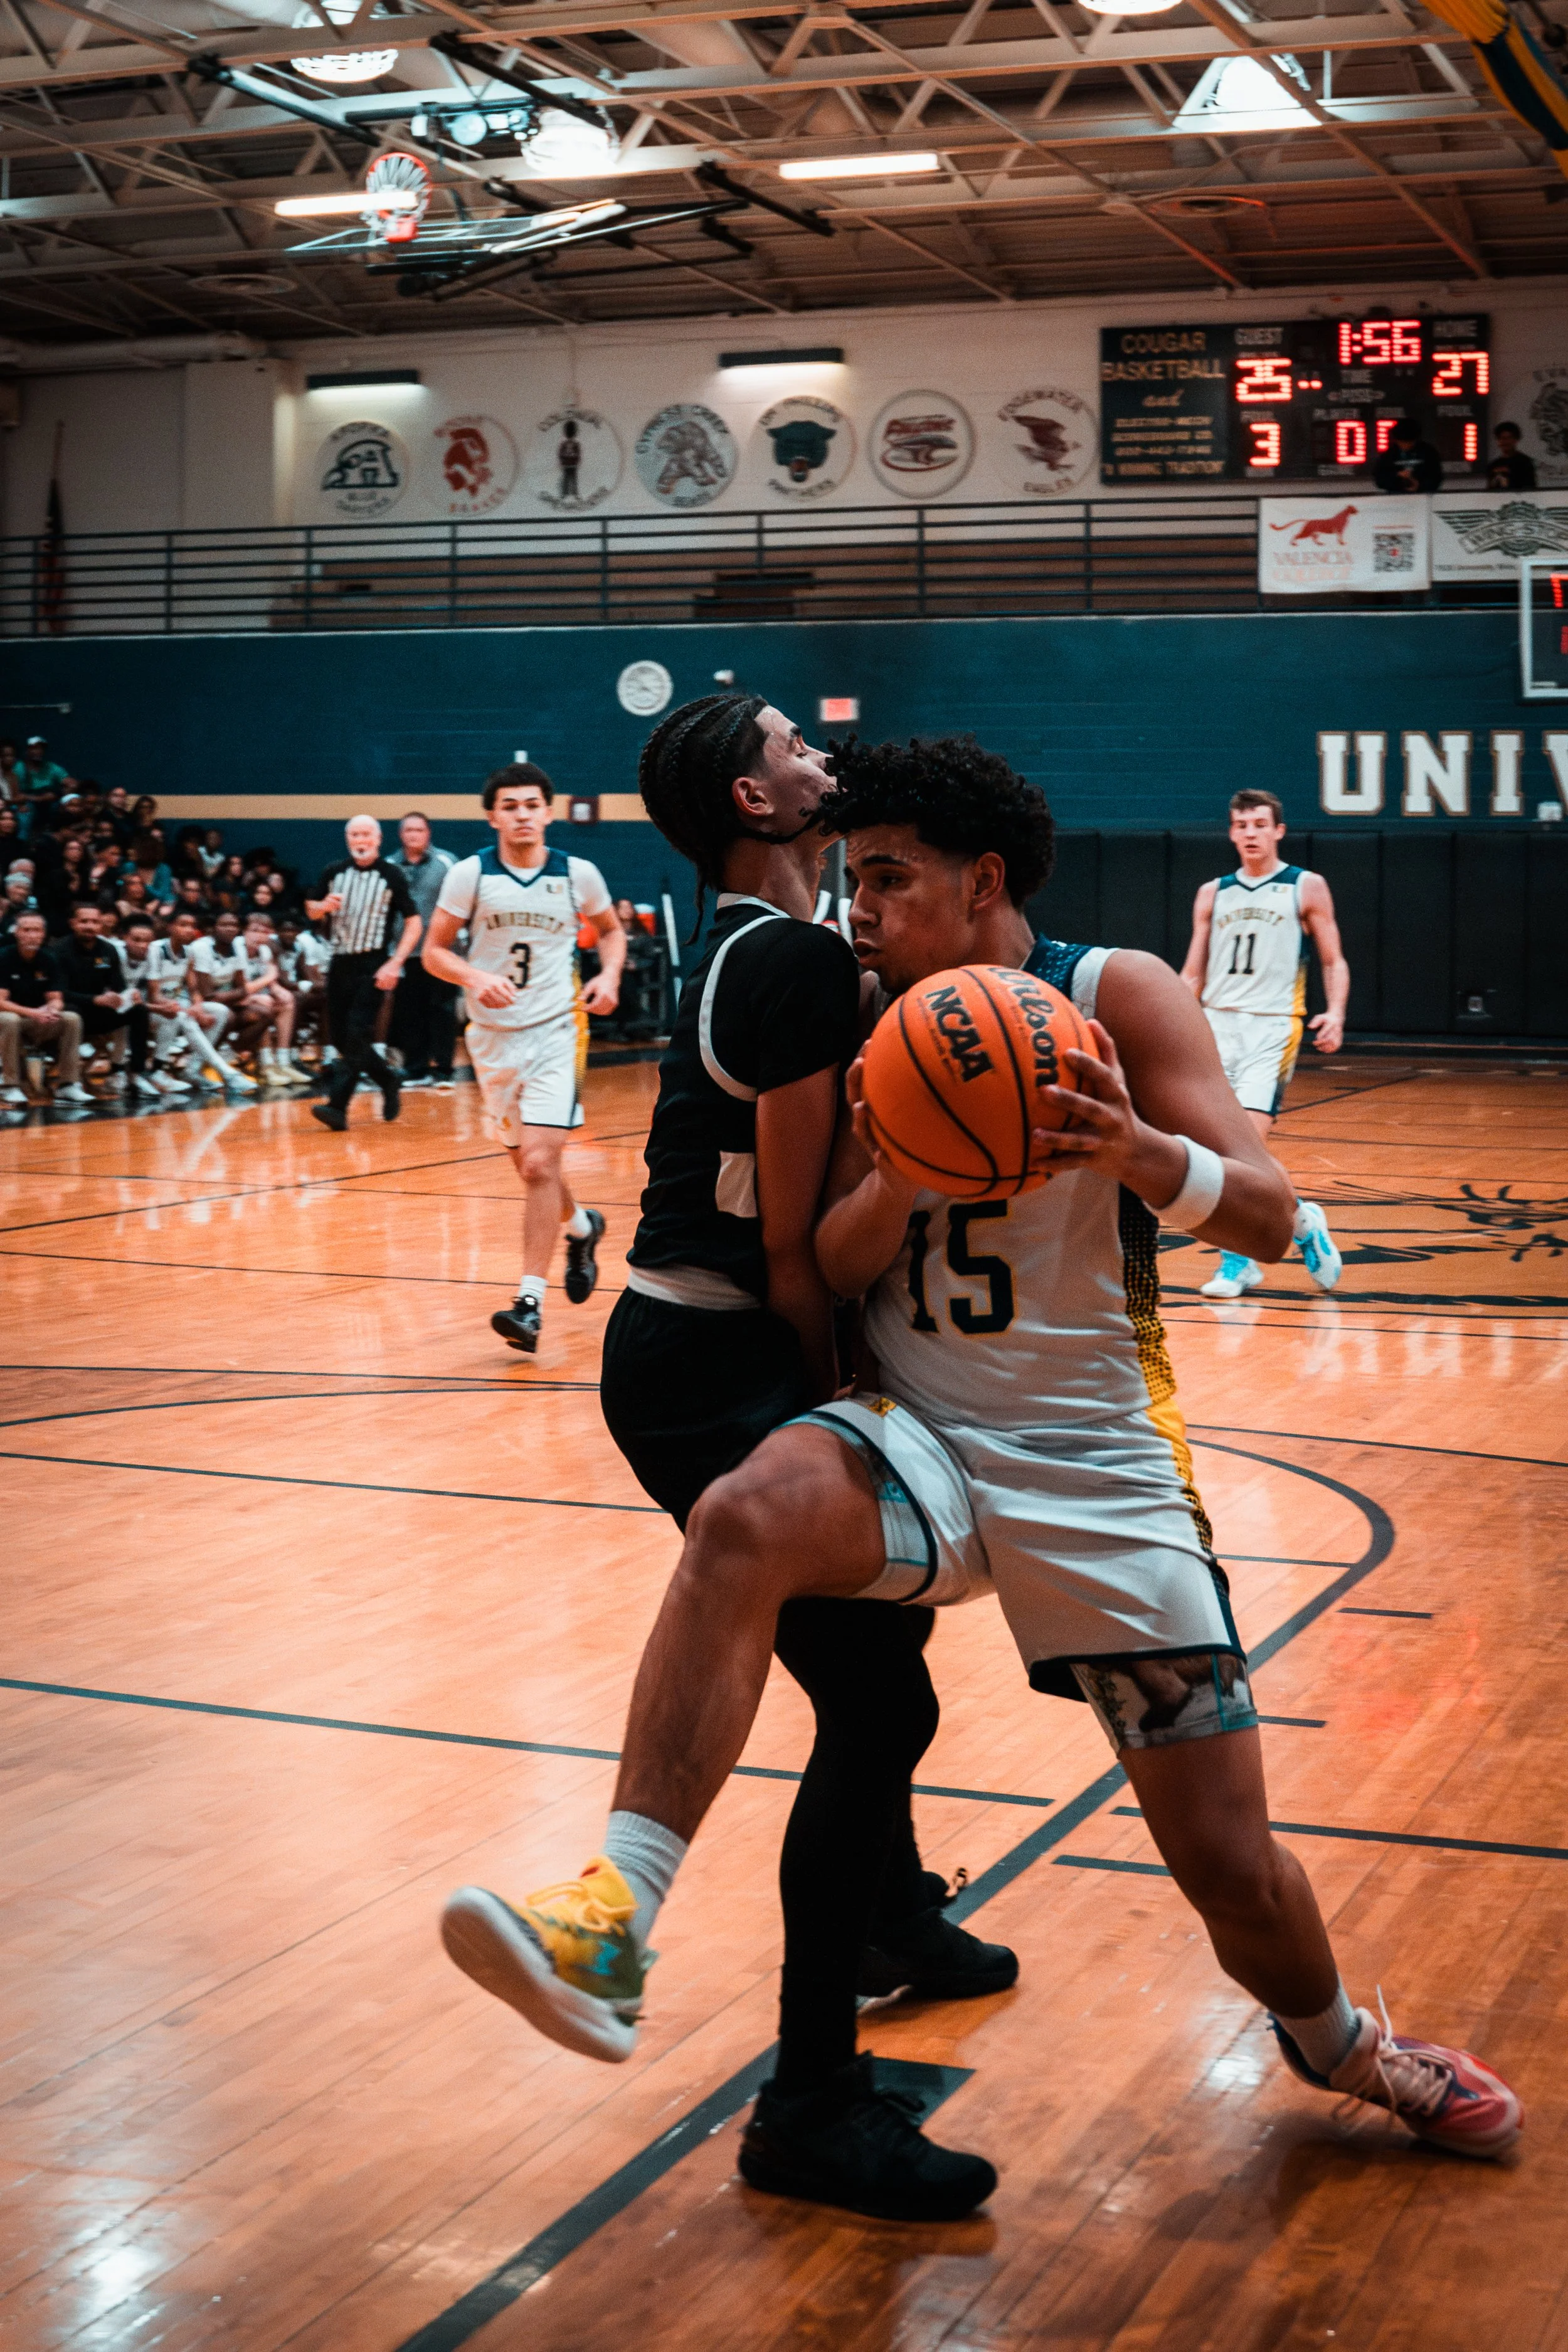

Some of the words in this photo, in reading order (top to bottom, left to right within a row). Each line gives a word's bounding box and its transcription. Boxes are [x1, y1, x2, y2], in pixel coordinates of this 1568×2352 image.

[1121, 331, 1206, 354] COUGAR
[1234, 327, 1283, 345] GUEST
[1338, 320, 1421, 364] 1:56
[1100, 359, 1226, 381] BASKETBALL
[1236, 358, 1292, 403] 25
[1433, 352, 1490, 396] 27
[1249, 422, 1281, 467] 3
[1465, 423, 1478, 462] 1
[509, 942, 532, 989] 3
[1227, 933, 1257, 975] 11
[924, 985, 995, 1083] NCAA
[908, 1198, 1017, 1335] 15
